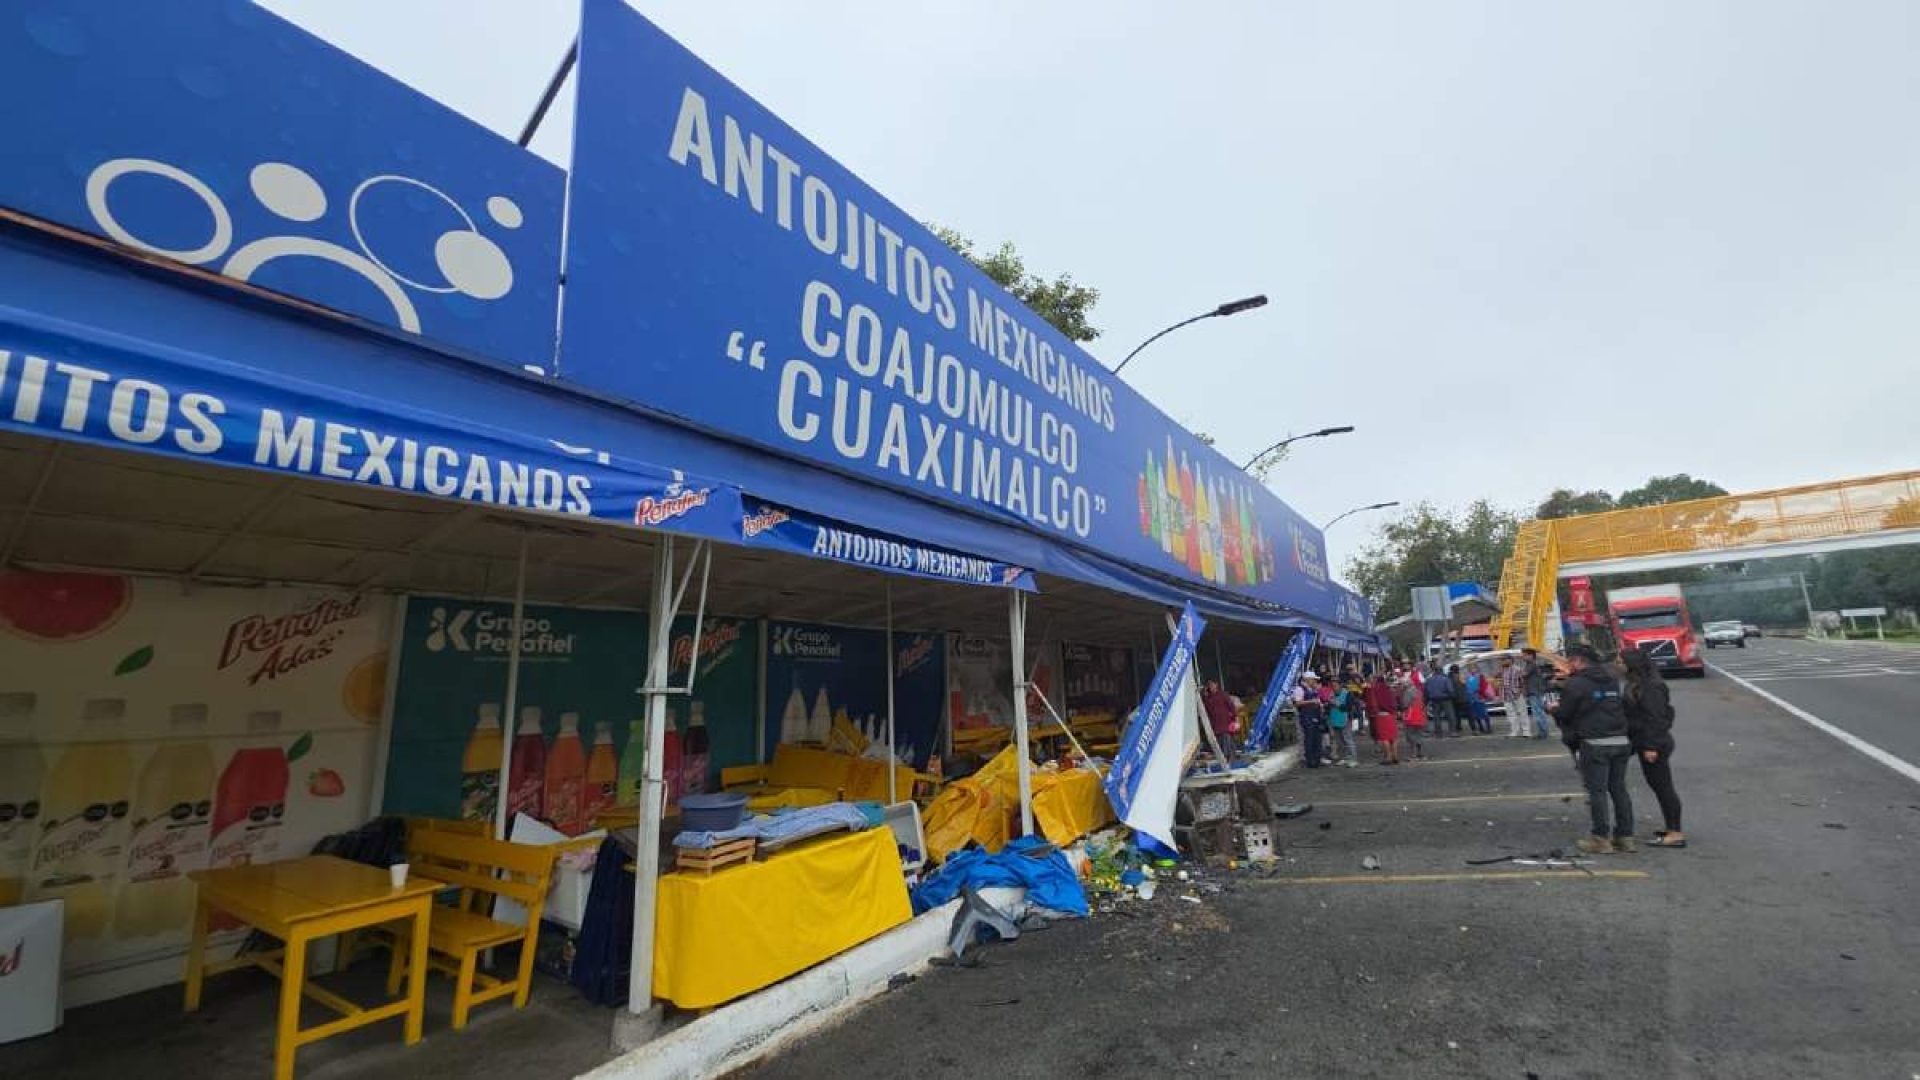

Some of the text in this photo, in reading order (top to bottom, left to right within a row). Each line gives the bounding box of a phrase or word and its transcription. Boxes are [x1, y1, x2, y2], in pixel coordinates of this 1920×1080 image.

[667, 86, 1114, 432] ANTOJITOS MEXICANOS
[801, 280, 1078, 474] COAJOMULCO
[254, 408, 592, 517] MEXICANOS
[813, 526, 912, 569] ANTOJITOS
[916, 548, 993, 583] MEXICANOS
